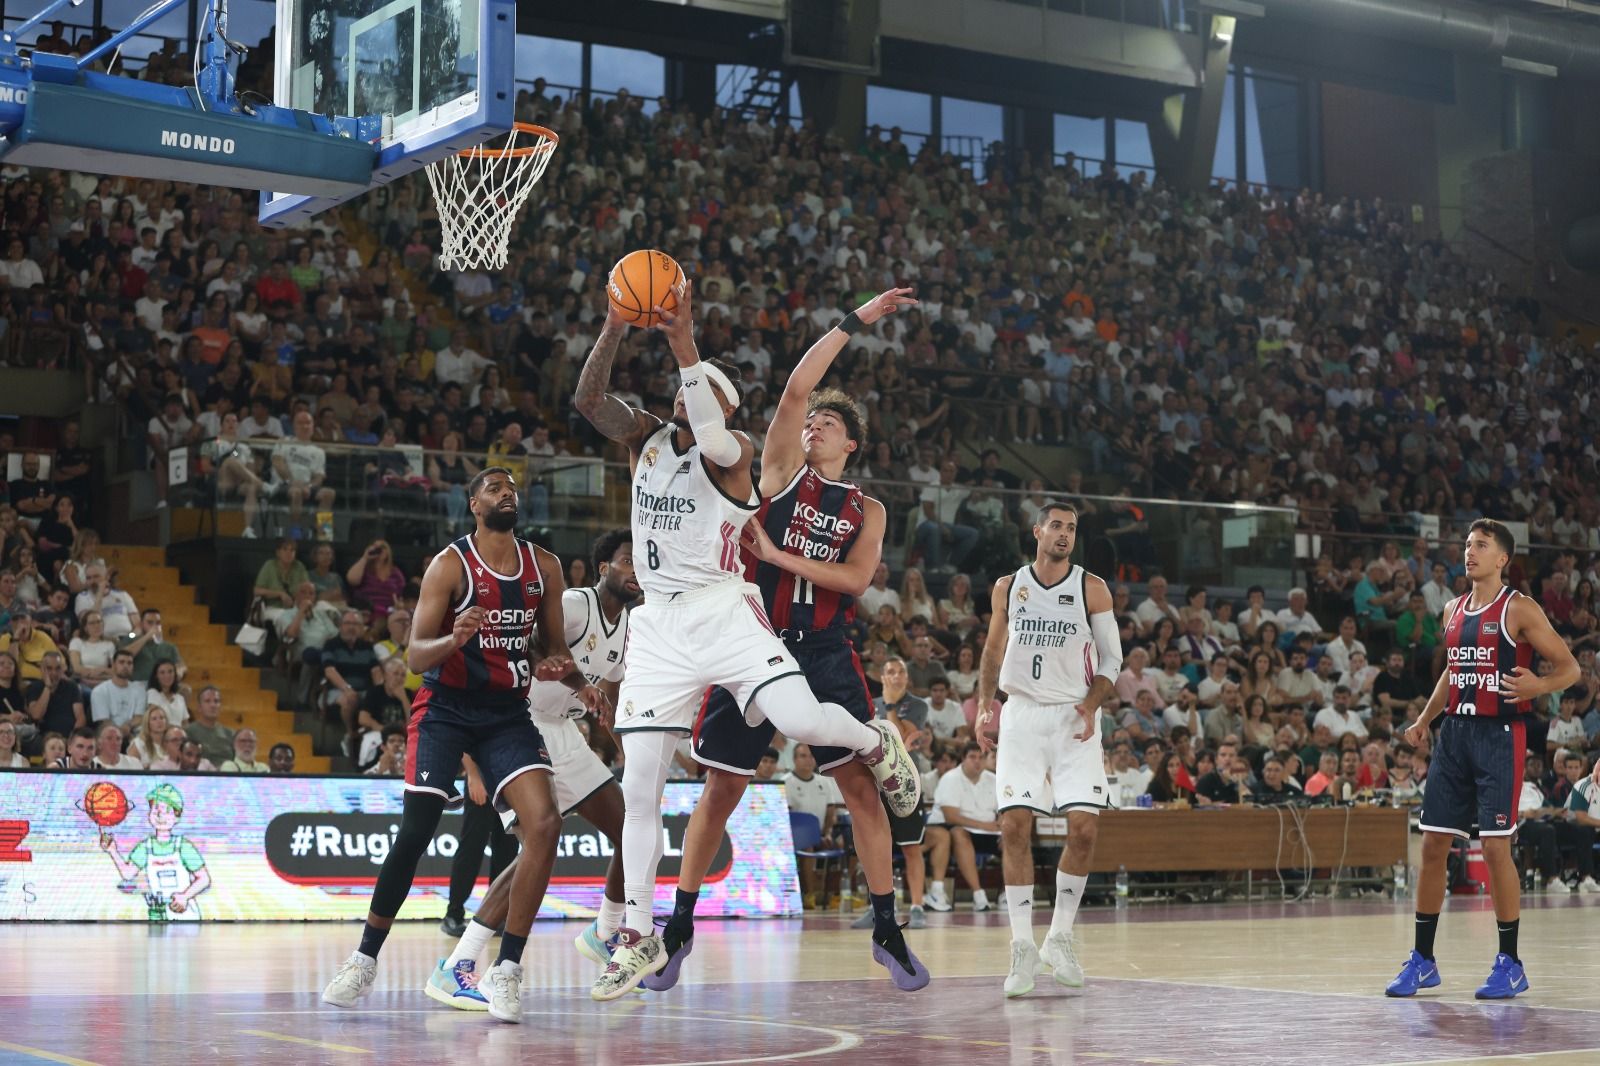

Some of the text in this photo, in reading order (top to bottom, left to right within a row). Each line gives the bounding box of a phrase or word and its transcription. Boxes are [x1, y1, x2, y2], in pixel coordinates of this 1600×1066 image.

[161, 130, 235, 154] MONDO
[647, 539, 660, 571] 8
[1014, 616, 1077, 635] Emirates
[1018, 633, 1066, 648] FLY BETTER
[508, 660, 530, 688] 19
[1031, 654, 1043, 680] 6
